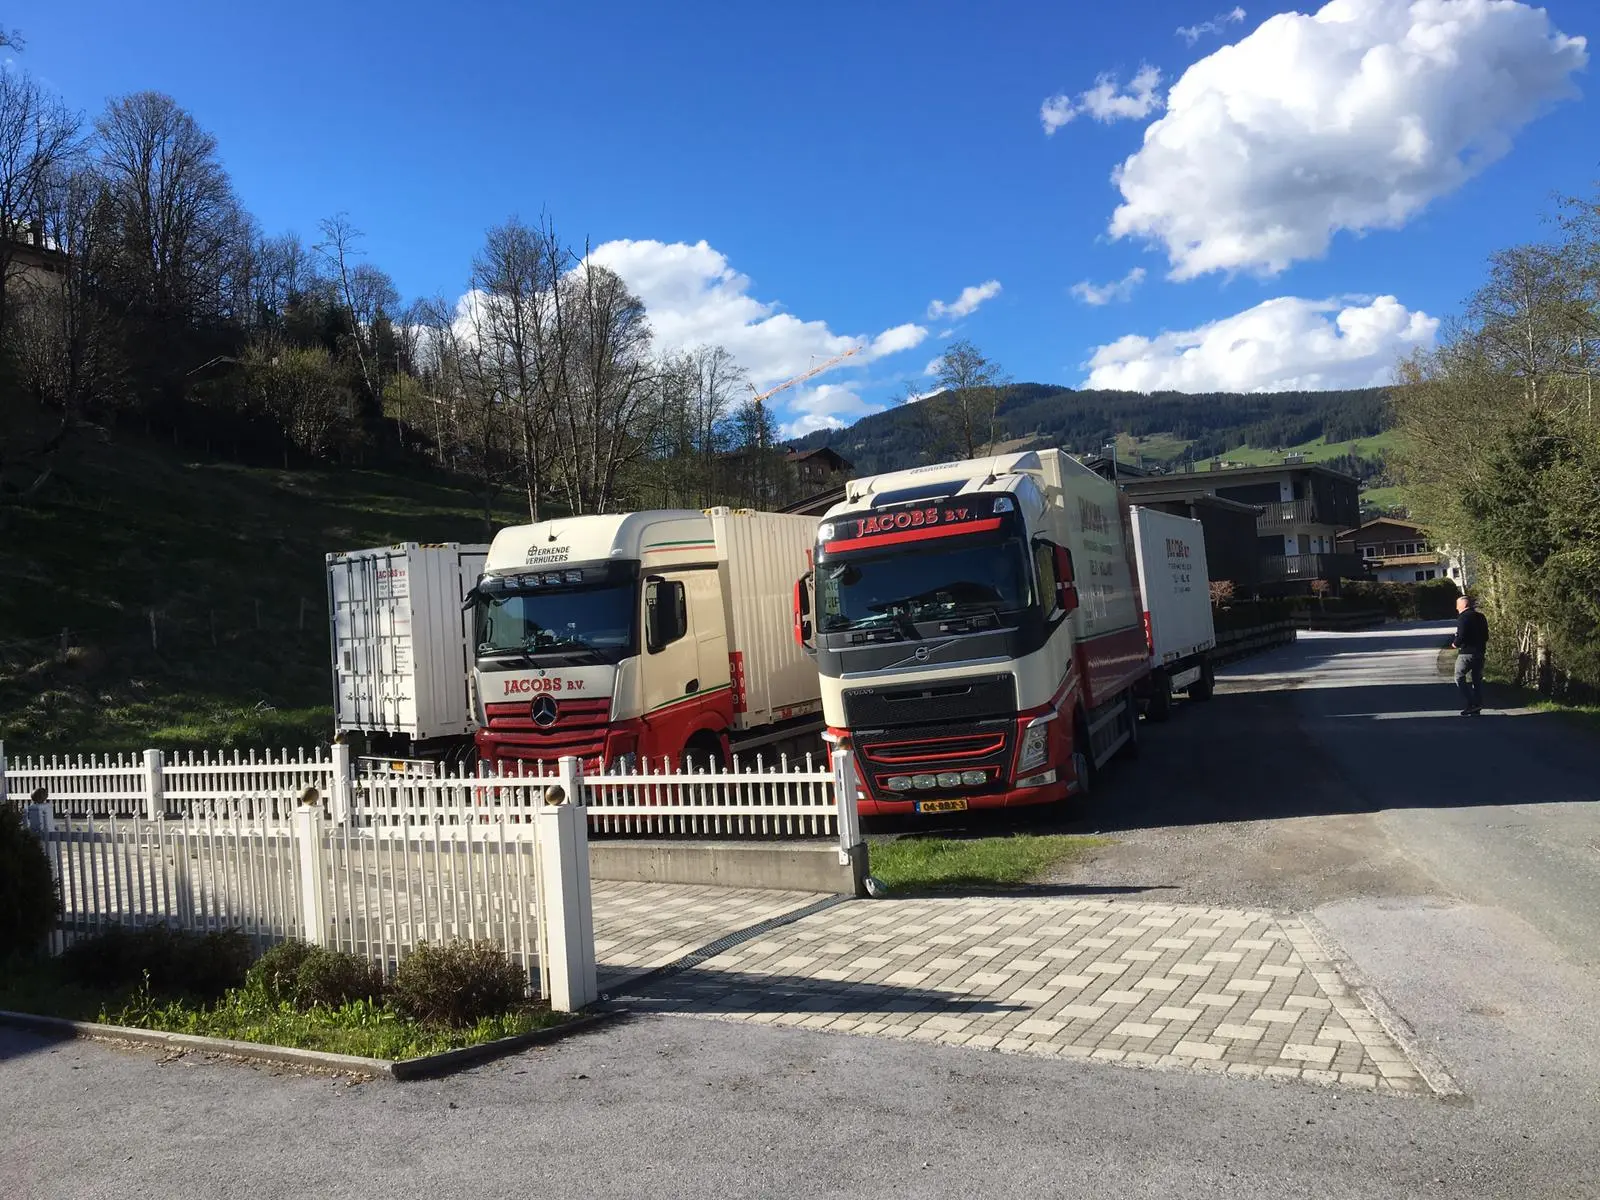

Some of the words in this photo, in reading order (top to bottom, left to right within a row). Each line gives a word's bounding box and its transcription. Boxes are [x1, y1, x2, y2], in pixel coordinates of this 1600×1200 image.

[856, 508, 938, 537] JACOBS
[945, 508, 970, 521] B.V.
[525, 554, 568, 565] VERHUIZERS
[504, 677, 562, 696] JACOBS
[566, 680, 585, 690] B.V.
